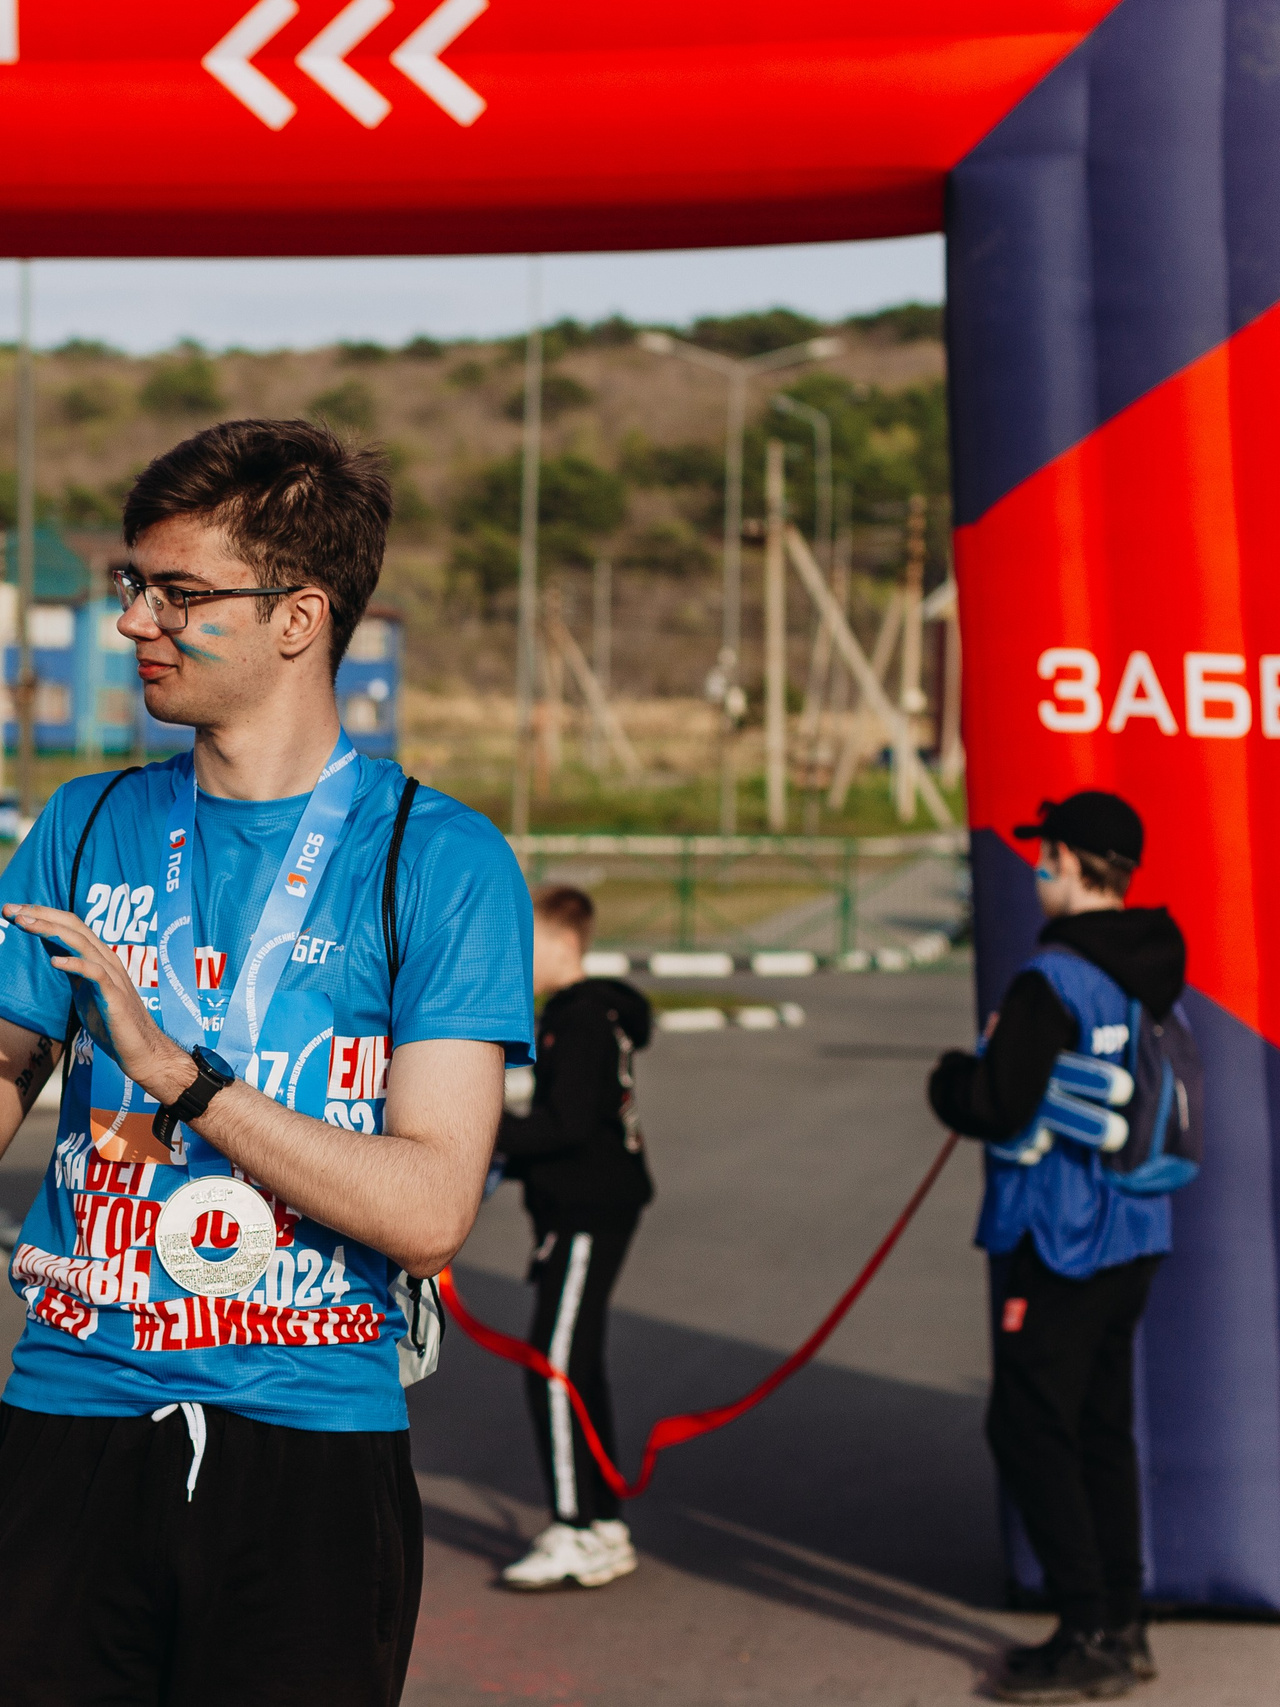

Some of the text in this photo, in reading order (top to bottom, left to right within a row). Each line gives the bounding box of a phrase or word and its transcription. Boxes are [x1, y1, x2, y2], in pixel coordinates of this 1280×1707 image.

[166, 851, 182, 893] ПСБ
[296, 832, 325, 872] ПСБ
[86, 882, 158, 942] 202
